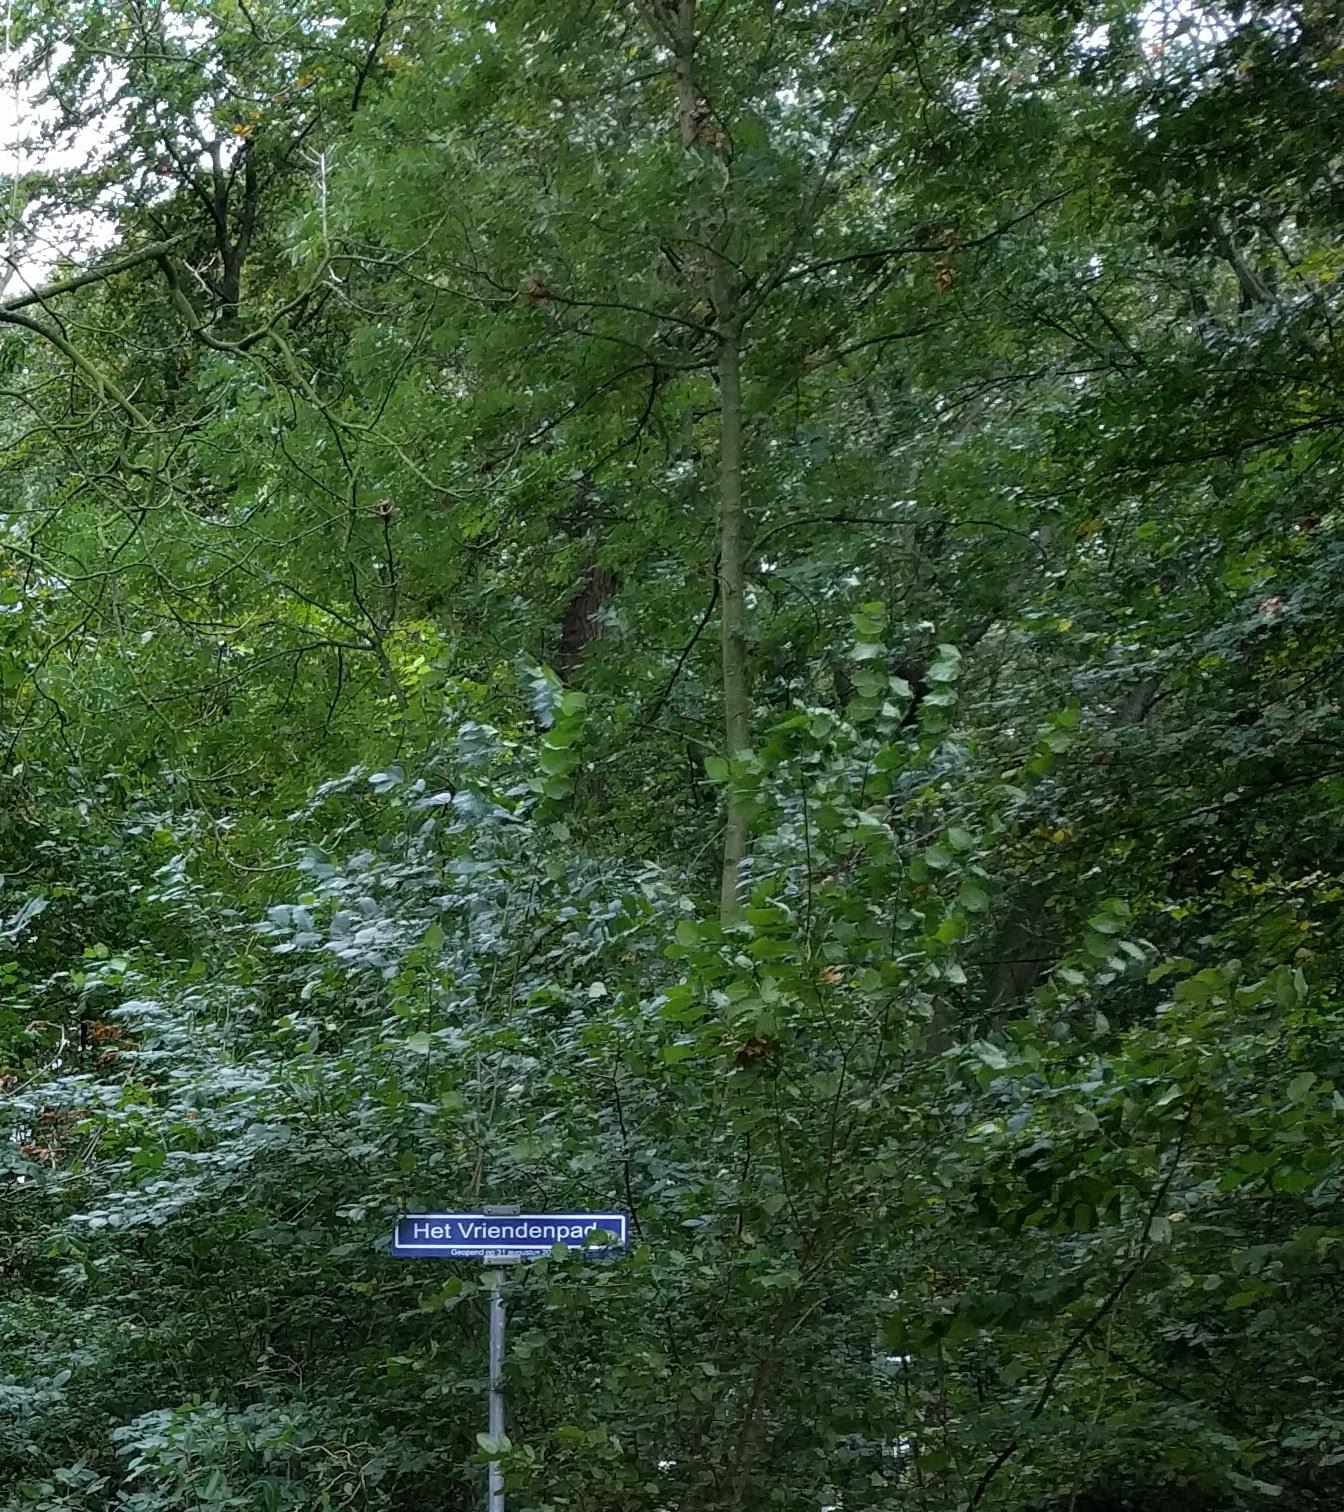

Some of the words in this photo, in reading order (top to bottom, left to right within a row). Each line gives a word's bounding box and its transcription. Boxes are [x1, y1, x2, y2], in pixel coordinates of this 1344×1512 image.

[413, 1222, 452, 1239] Het
[458, 1222, 597, 1241] Vriendenpad
[450, 1248, 484, 1257] Geopend
